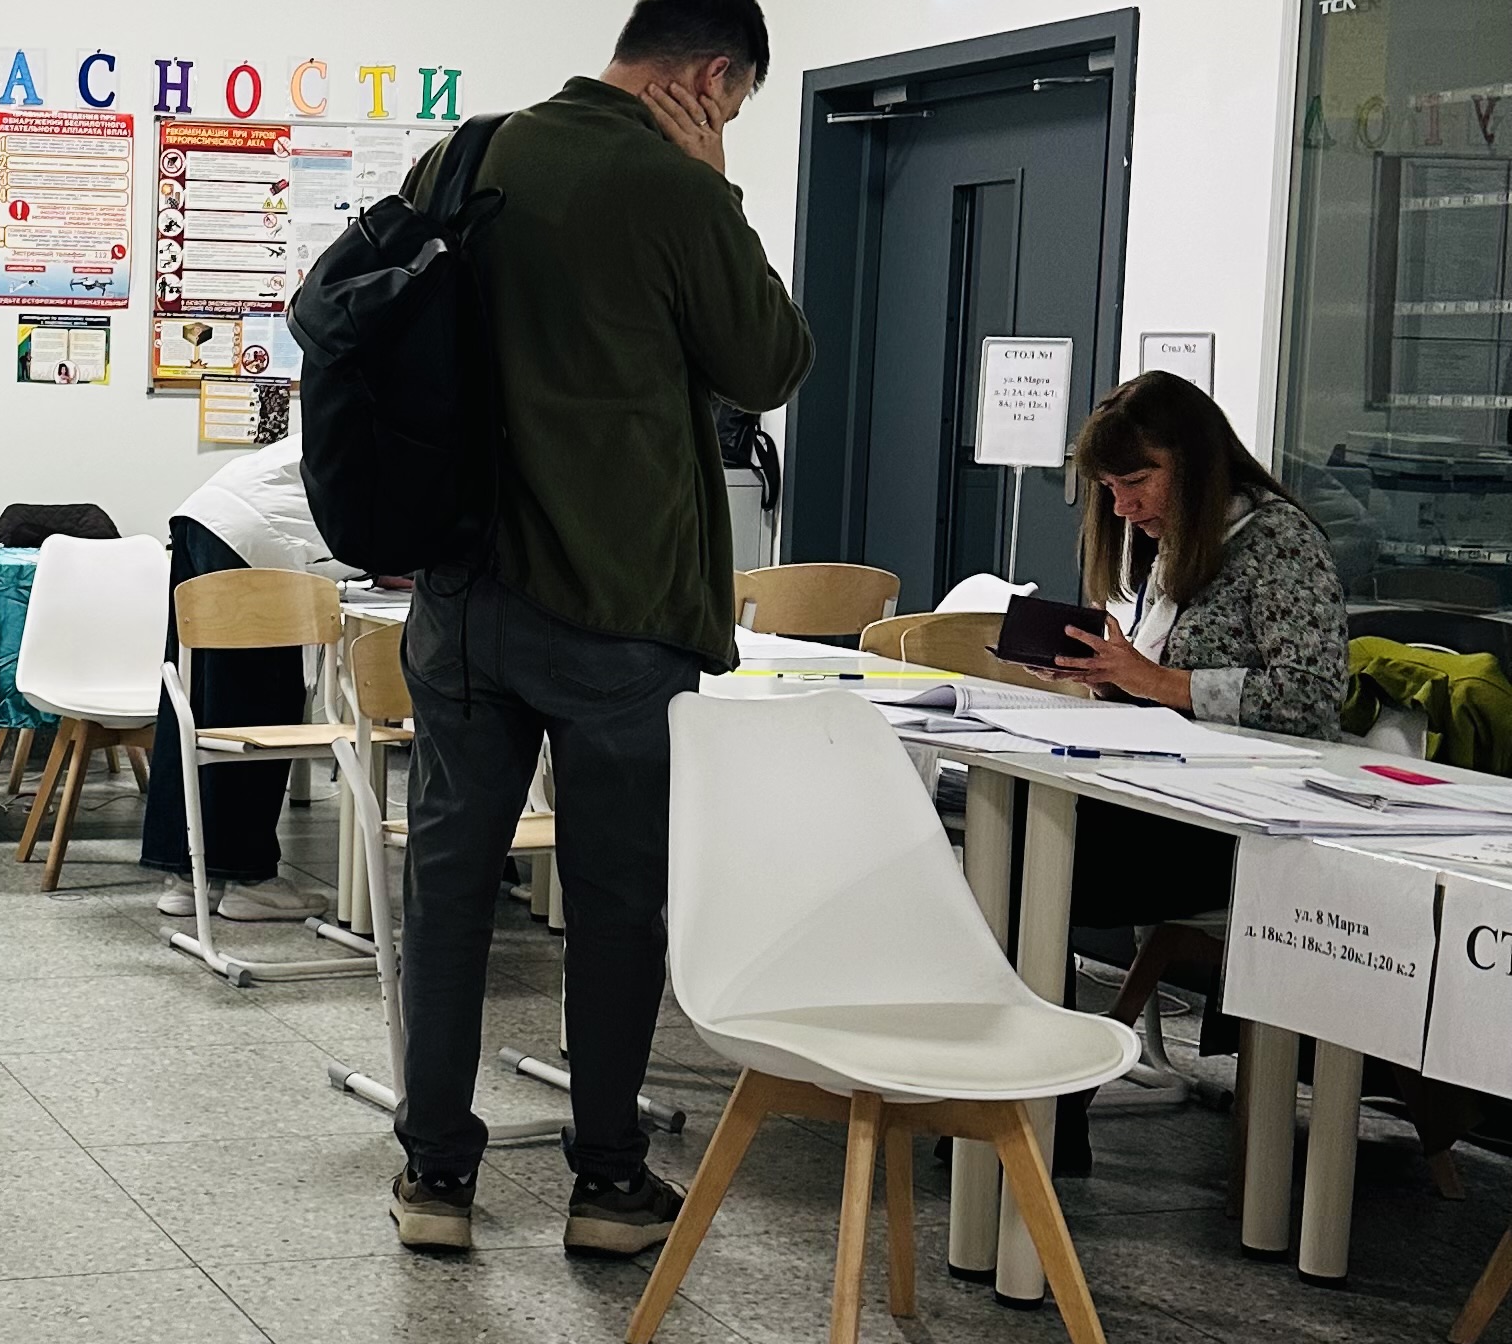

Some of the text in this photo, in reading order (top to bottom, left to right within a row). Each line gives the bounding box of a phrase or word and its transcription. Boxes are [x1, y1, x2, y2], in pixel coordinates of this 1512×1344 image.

[233, 130, 247, 138] ПРИ
[1161, 343, 1181, 353] Стол
[1004, 350, 1053, 360] СТОЛ №1
[1024, 376, 1050, 385] Марта
[1294, 908, 1370, 936] ул. 8 Марта
[1244, 925, 1257, 937] д.
[1261, 925, 1298, 949] 18к.2;
[1301, 935, 1337, 960] 18к.3;
[1396, 962, 1416, 978] к.2
